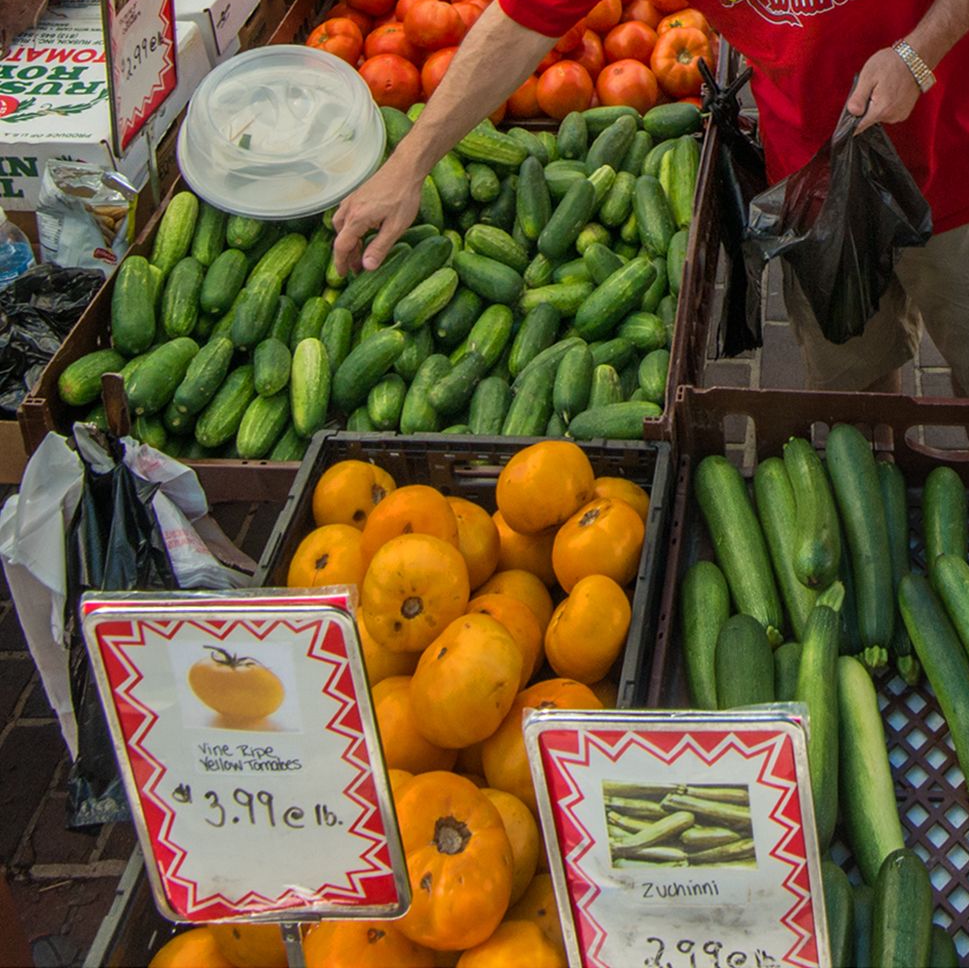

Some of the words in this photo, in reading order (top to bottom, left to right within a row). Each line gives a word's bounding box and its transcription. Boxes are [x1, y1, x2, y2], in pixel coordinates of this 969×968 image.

[198, 743, 233, 757] Vine
[236, 744, 276, 761] Ripe
[199, 757, 243, 772] Yellow
[243, 757, 303, 771] Tomatoes
